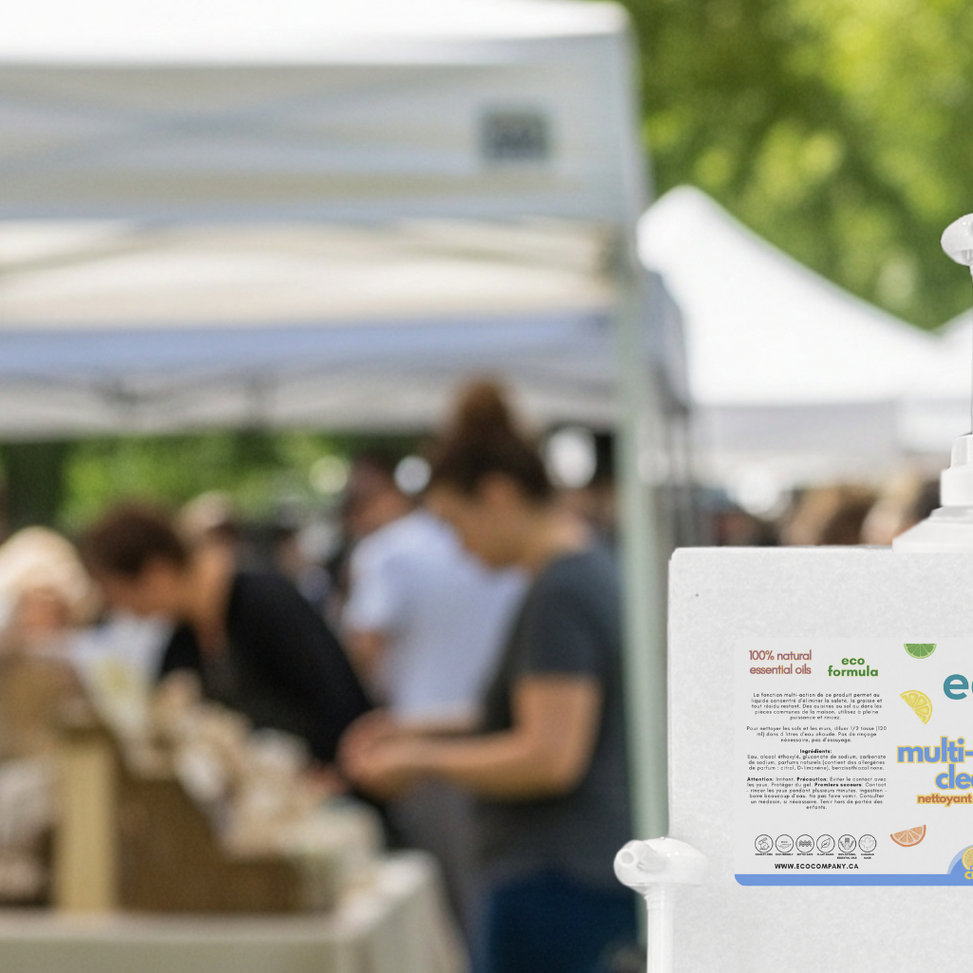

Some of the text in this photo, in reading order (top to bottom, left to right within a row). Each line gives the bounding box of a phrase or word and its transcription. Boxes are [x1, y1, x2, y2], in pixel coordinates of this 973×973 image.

[749, 649, 812, 661] 100% natural
[749, 663, 812, 675] essential oils
[827, 665, 878, 677] formula
[917, 793, 971, 807] nettoyant
